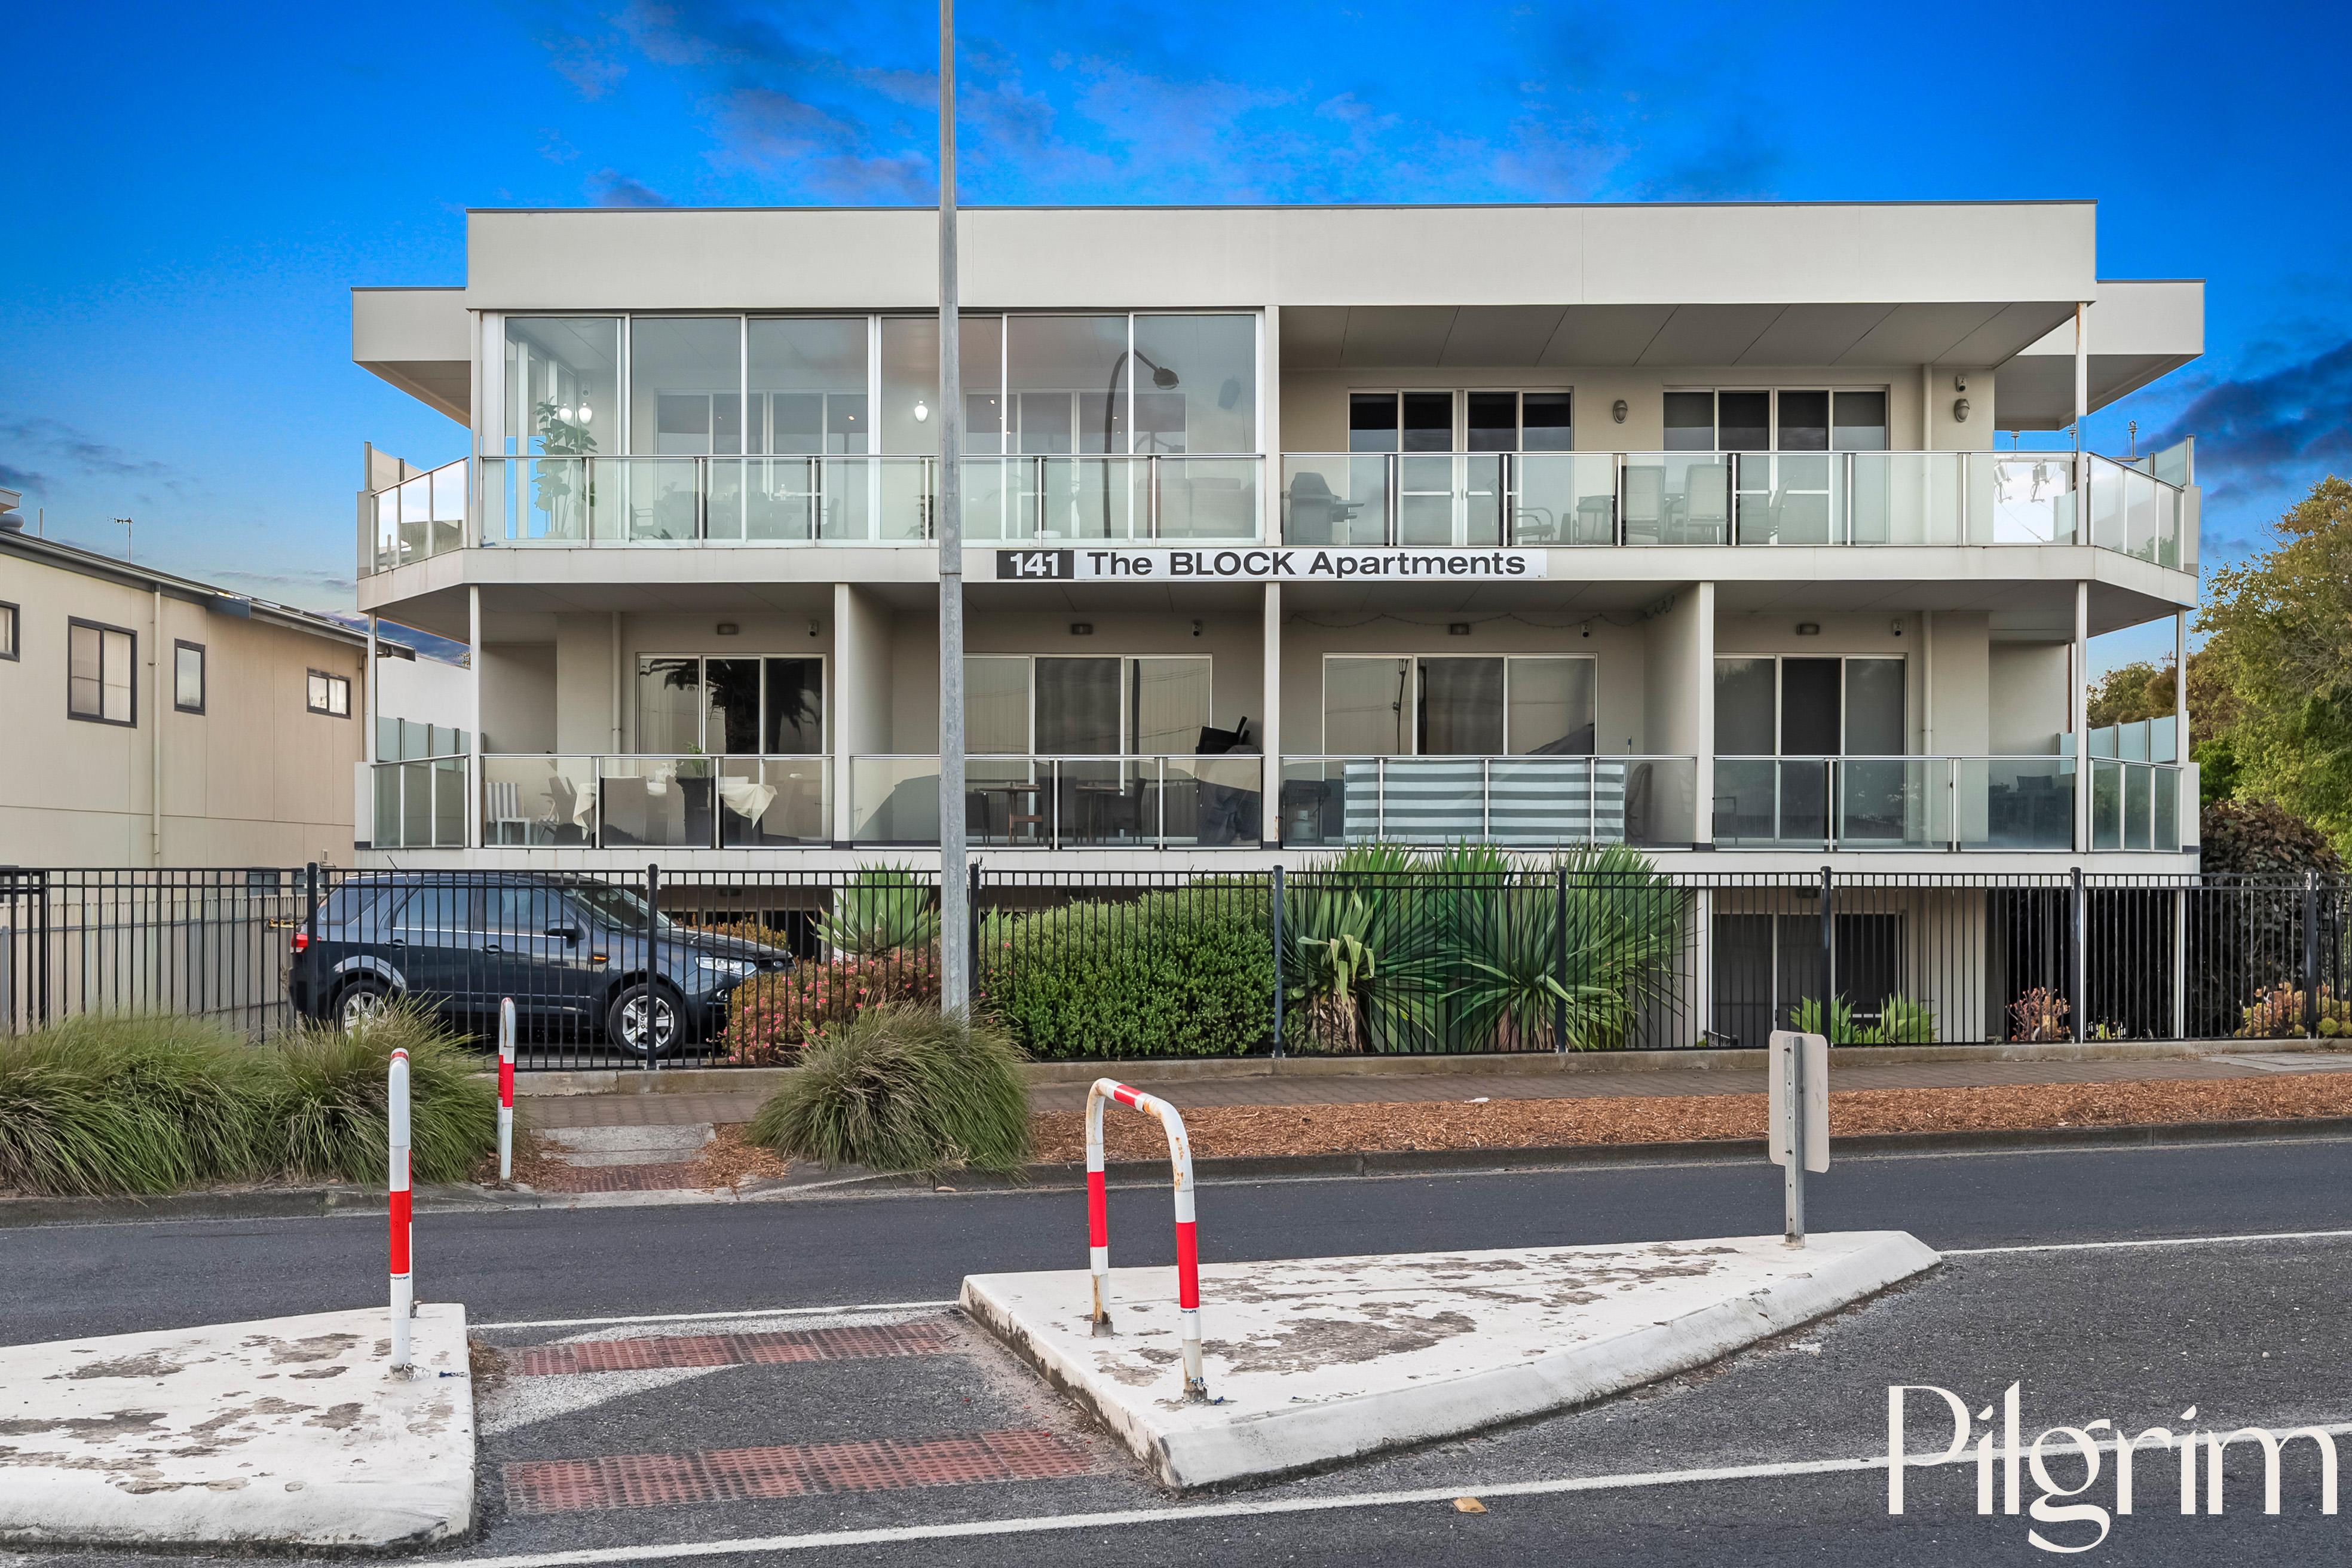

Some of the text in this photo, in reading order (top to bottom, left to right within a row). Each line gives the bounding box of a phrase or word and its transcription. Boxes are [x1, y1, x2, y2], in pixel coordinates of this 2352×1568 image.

[1010, 551, 1525, 578] 141 The BLOCK Apartments
